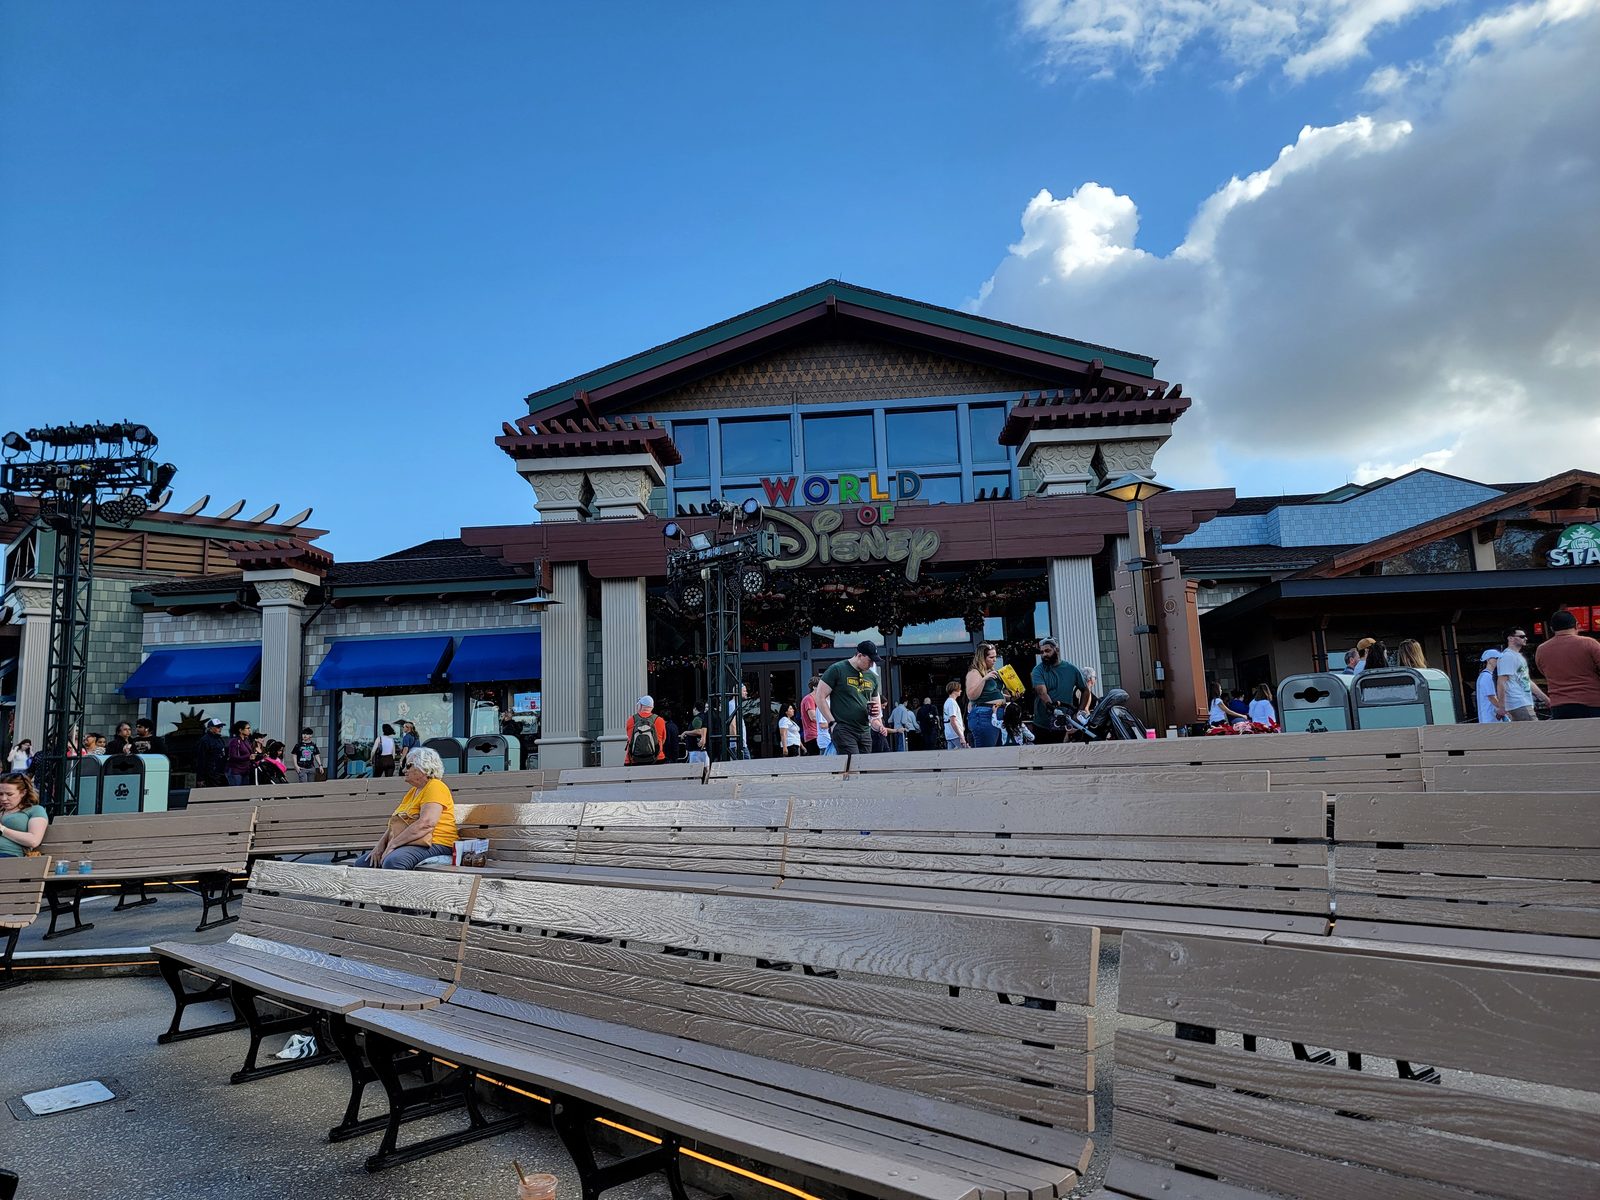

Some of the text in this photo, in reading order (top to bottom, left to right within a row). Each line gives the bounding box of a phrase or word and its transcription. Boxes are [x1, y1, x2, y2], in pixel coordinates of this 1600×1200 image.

[760, 470, 922, 507] WORLD
[857, 504, 895, 526] OF
[1550, 547, 1600, 566] STA
